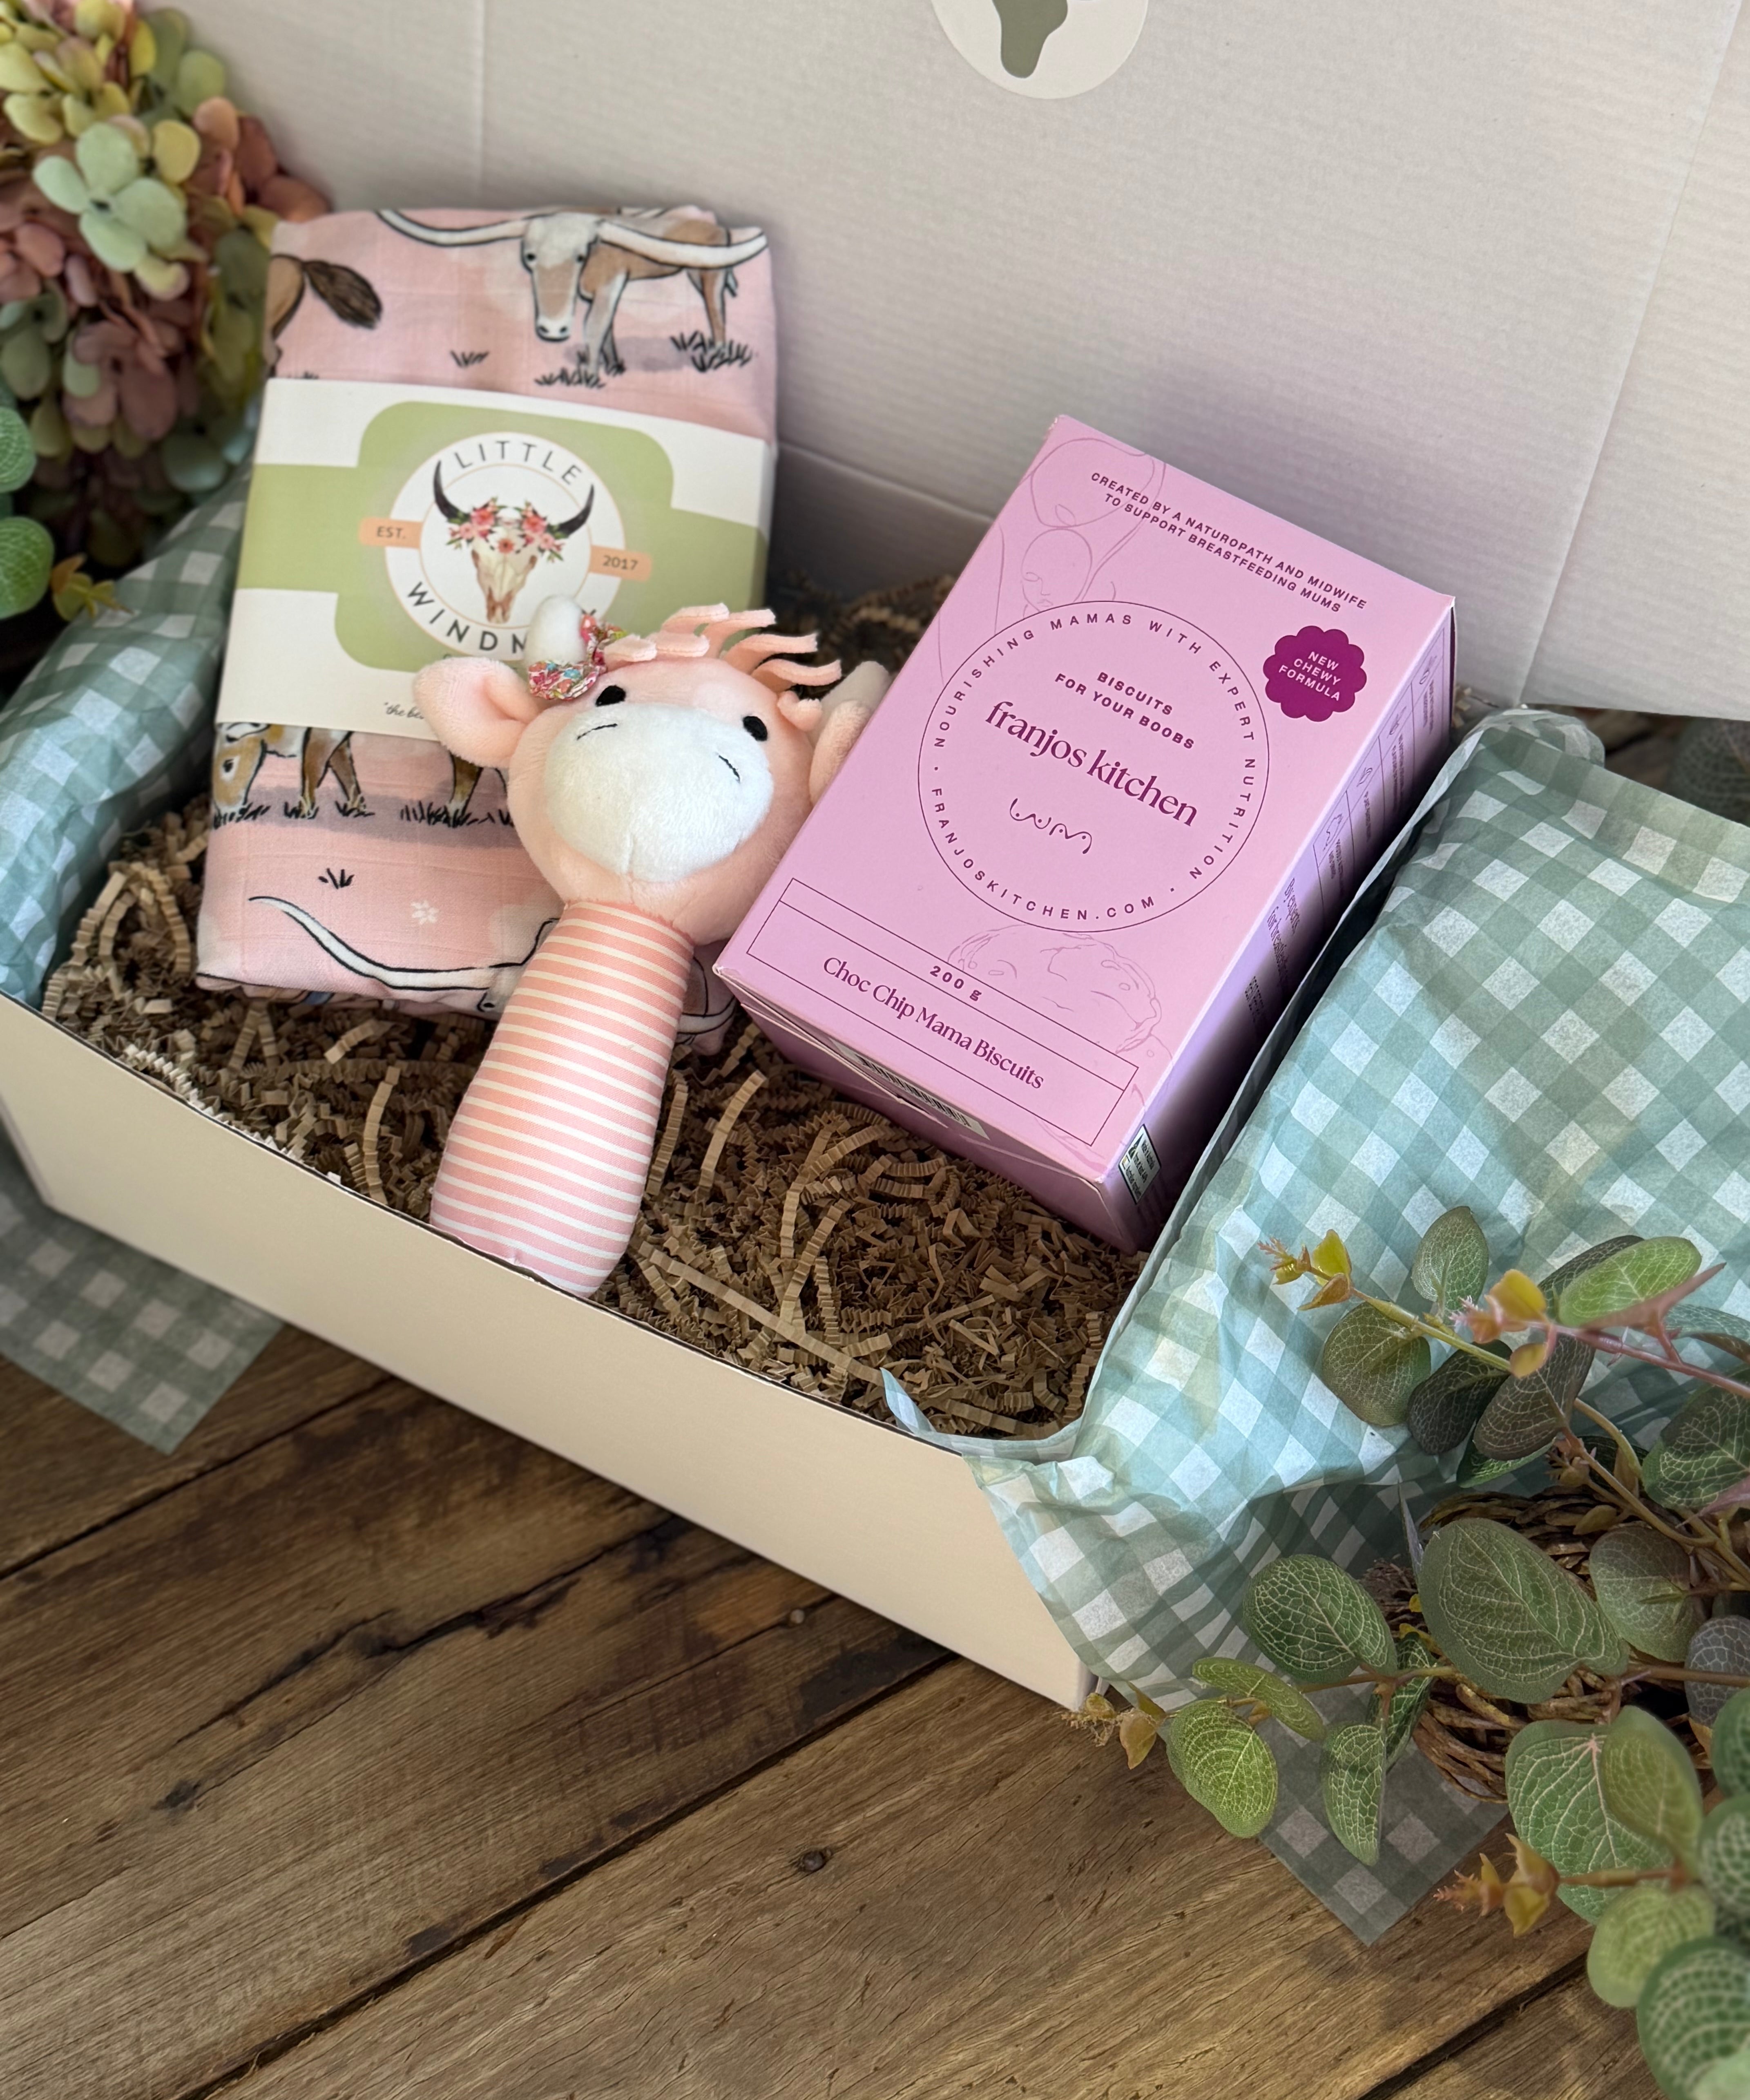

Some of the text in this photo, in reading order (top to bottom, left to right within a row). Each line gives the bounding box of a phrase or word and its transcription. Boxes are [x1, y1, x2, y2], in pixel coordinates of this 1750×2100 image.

[454, 441, 582, 485] LITTLE
[376, 526, 407, 539] EST.
[1092, 473, 1366, 609] CREATED BY A NATUROPATH AND MIDWIFE
[1105, 494, 1340, 612] TO SUPPORT BREASTFEEDING MUMS
[603, 555, 638, 570] 2017
[407, 581, 597, 654] WINDM
[1050, 613, 1131, 630] MAMAS
[1150, 621, 1201, 654] WITH
[934, 630, 1034, 747] NOURISHING
[1279, 665, 1339, 701] FORMULA
[1294, 659, 1340, 685] CHEWY
[1308, 652, 1338, 670] NEW
[1055, 673, 1194, 749] FOR YOUR BOOBS
[1097, 672, 1172, 715] BISCUITS
[1209, 661, 1254, 740] EXPERT
[985, 701, 1197, 827] franjos kitchen
[1190, 759, 1255, 879] NUTRITION
[932, 789, 1154, 920] FRANJOSKITCHEN.COM
[930, 966, 982, 1001] 200 g
[824, 958, 1043, 1088] Choc Chip Mama Biscuits
